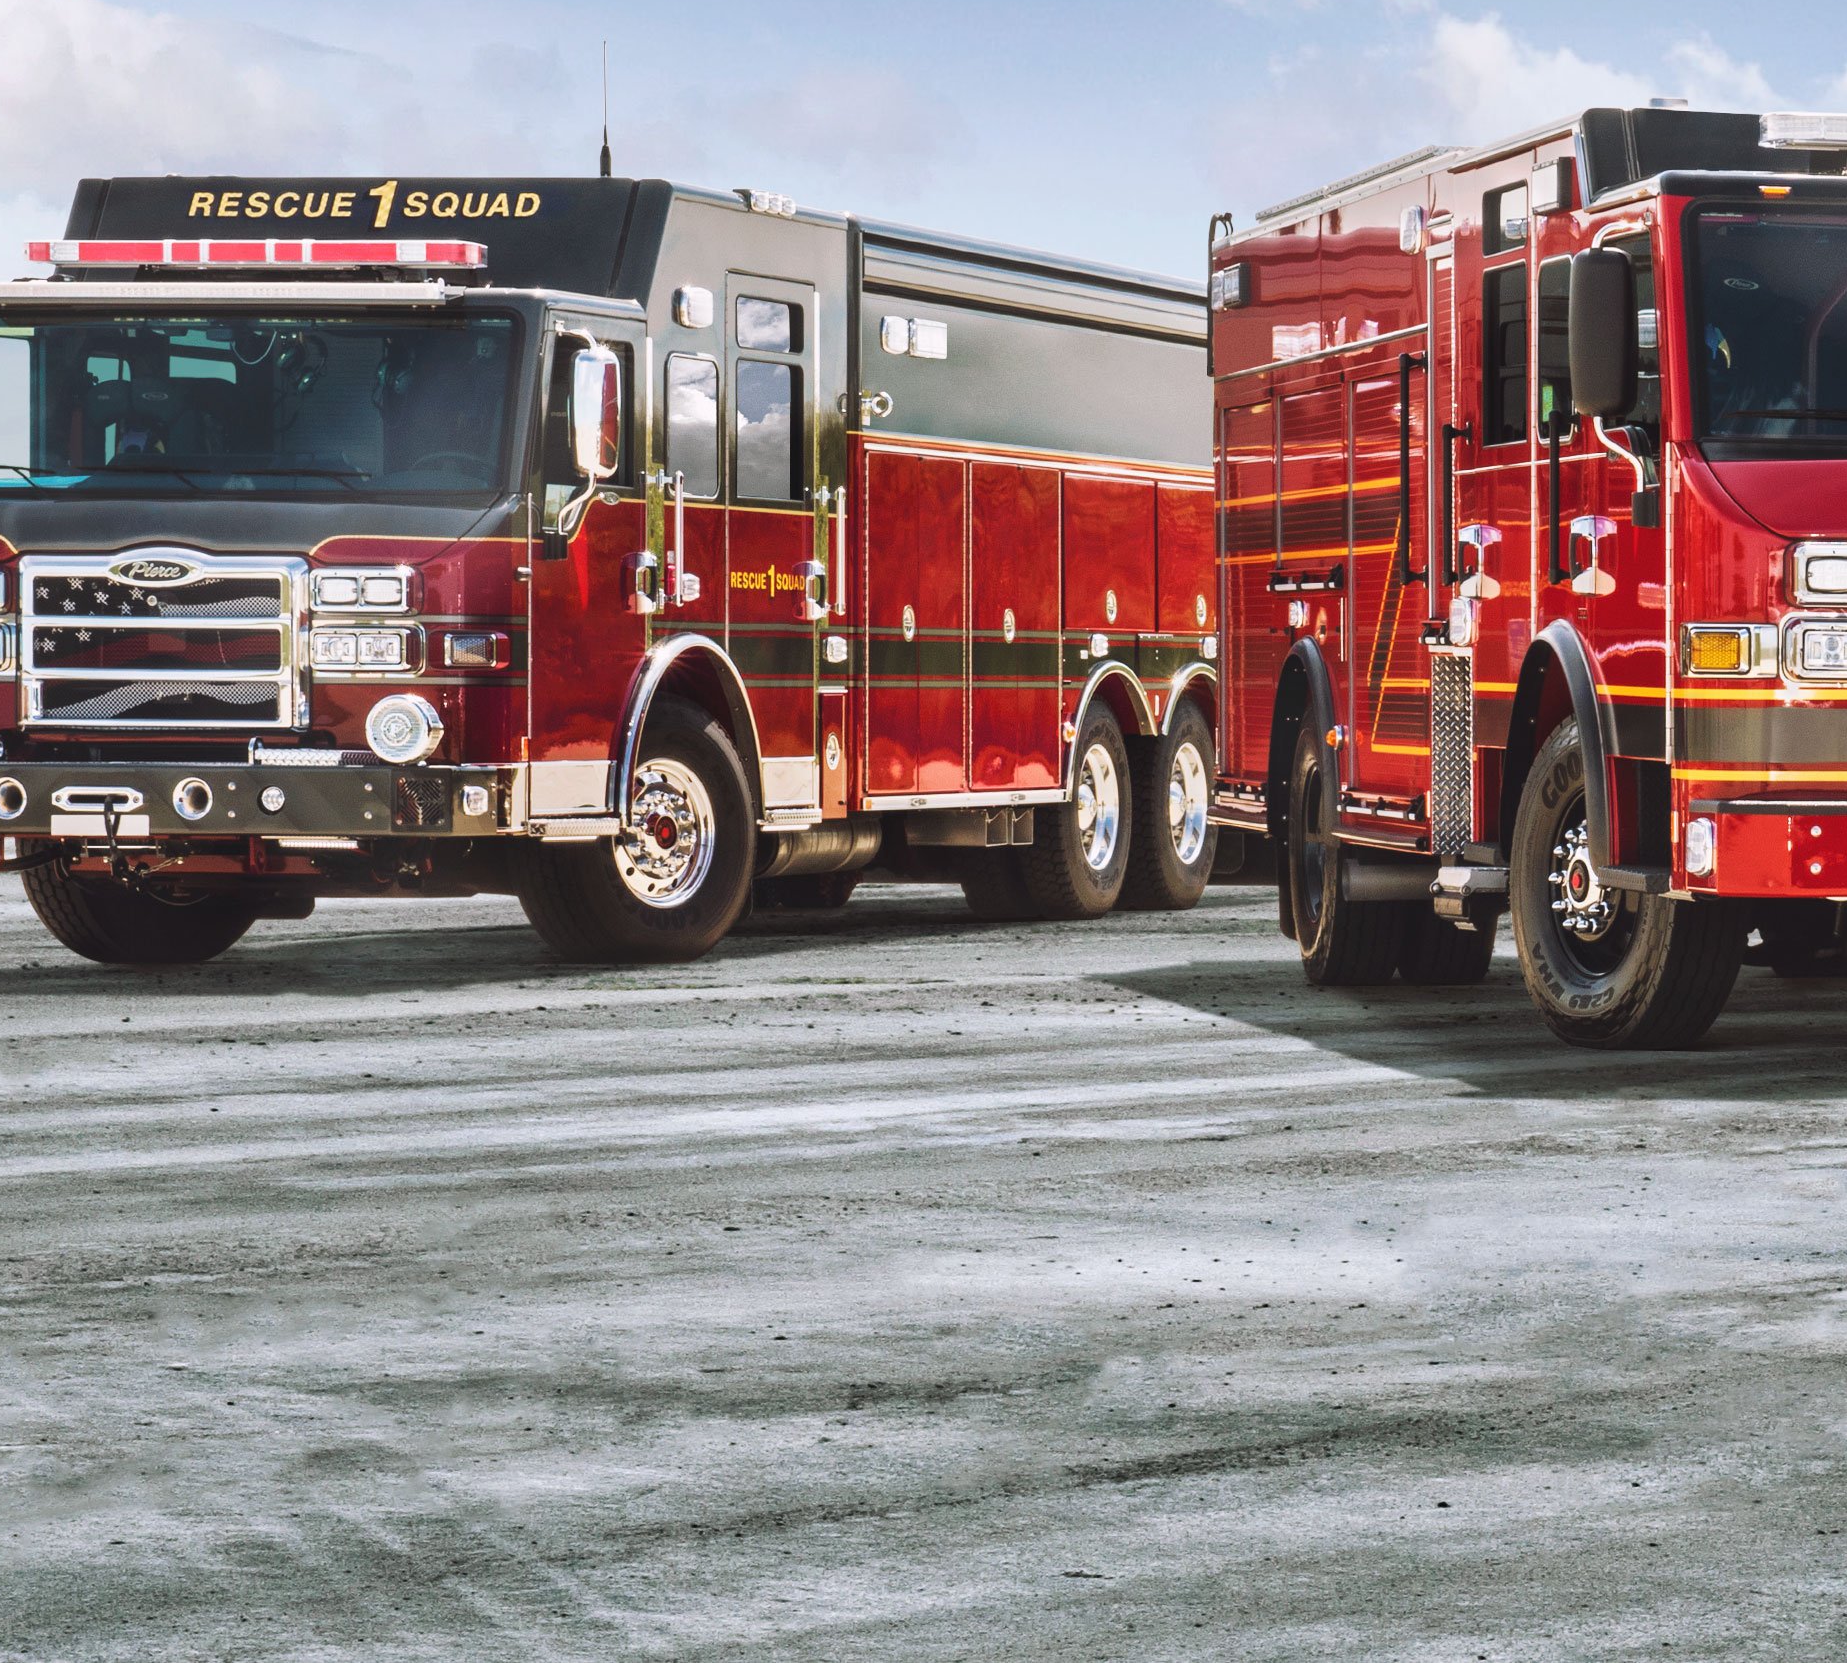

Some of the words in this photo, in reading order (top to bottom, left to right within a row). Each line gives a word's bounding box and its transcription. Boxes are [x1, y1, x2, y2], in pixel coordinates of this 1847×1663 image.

[187, 191, 357, 218] RESCUE
[368, 179, 399, 228] 1
[403, 191, 542, 218] SQUAD
[128, 561, 182, 579] Pierce
[730, 571, 767, 590] RESCUE
[767, 564, 776, 598] 1
[776, 573, 806, 591] SQUAD
[1541, 751, 1585, 810] GOO
